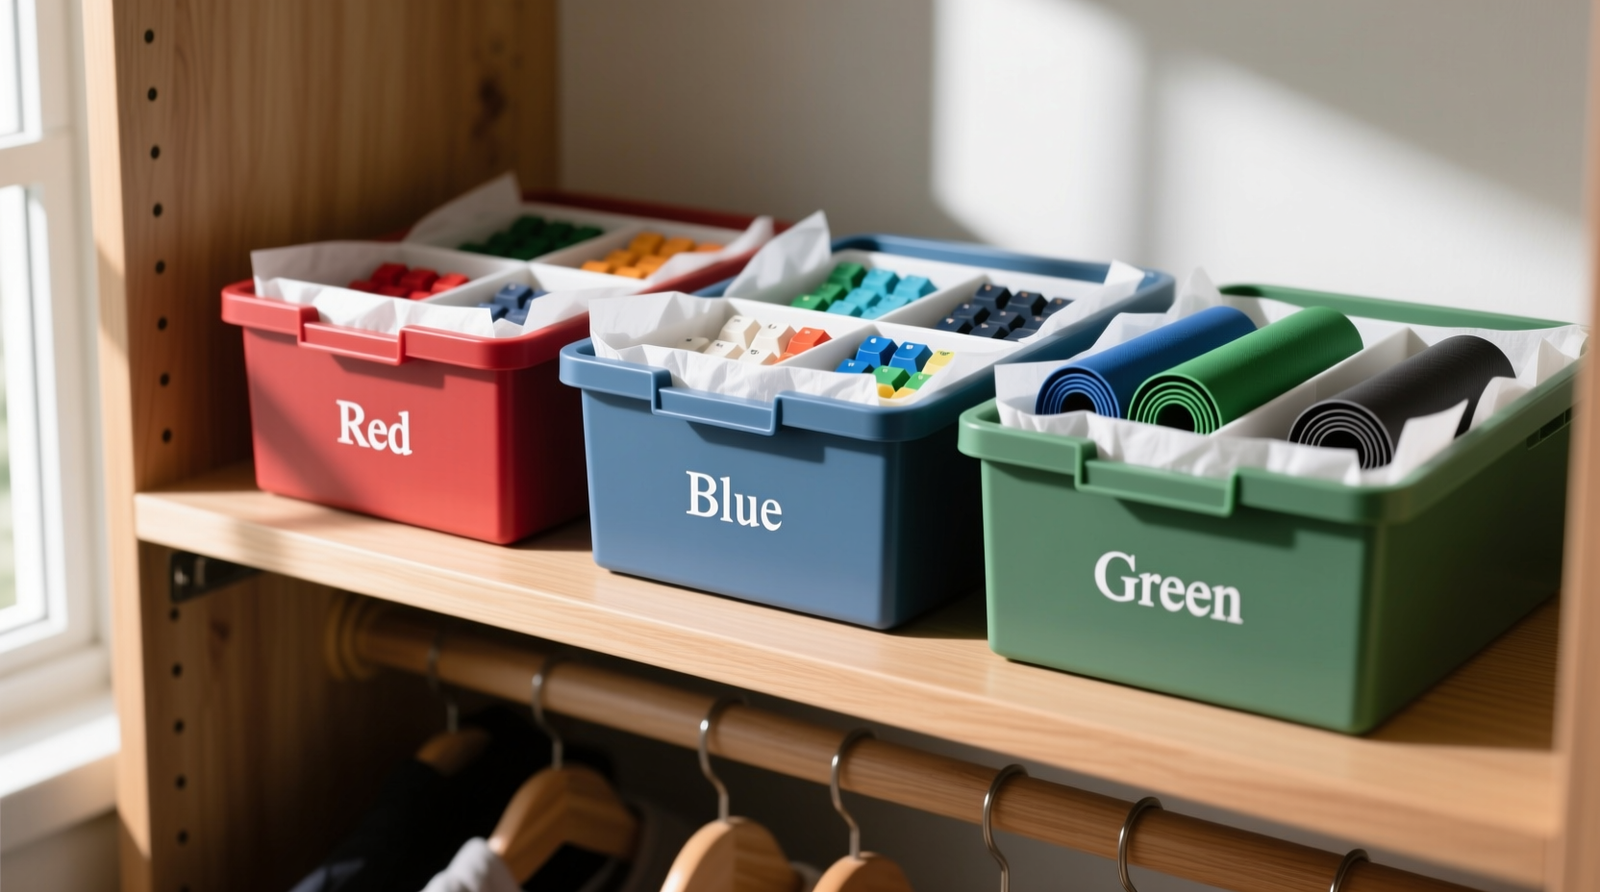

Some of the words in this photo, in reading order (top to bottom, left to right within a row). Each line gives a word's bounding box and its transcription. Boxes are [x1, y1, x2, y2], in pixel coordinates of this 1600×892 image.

[335, 398, 414, 457] Red
[685, 470, 783, 532] Blue
[1094, 550, 1244, 625] Green
